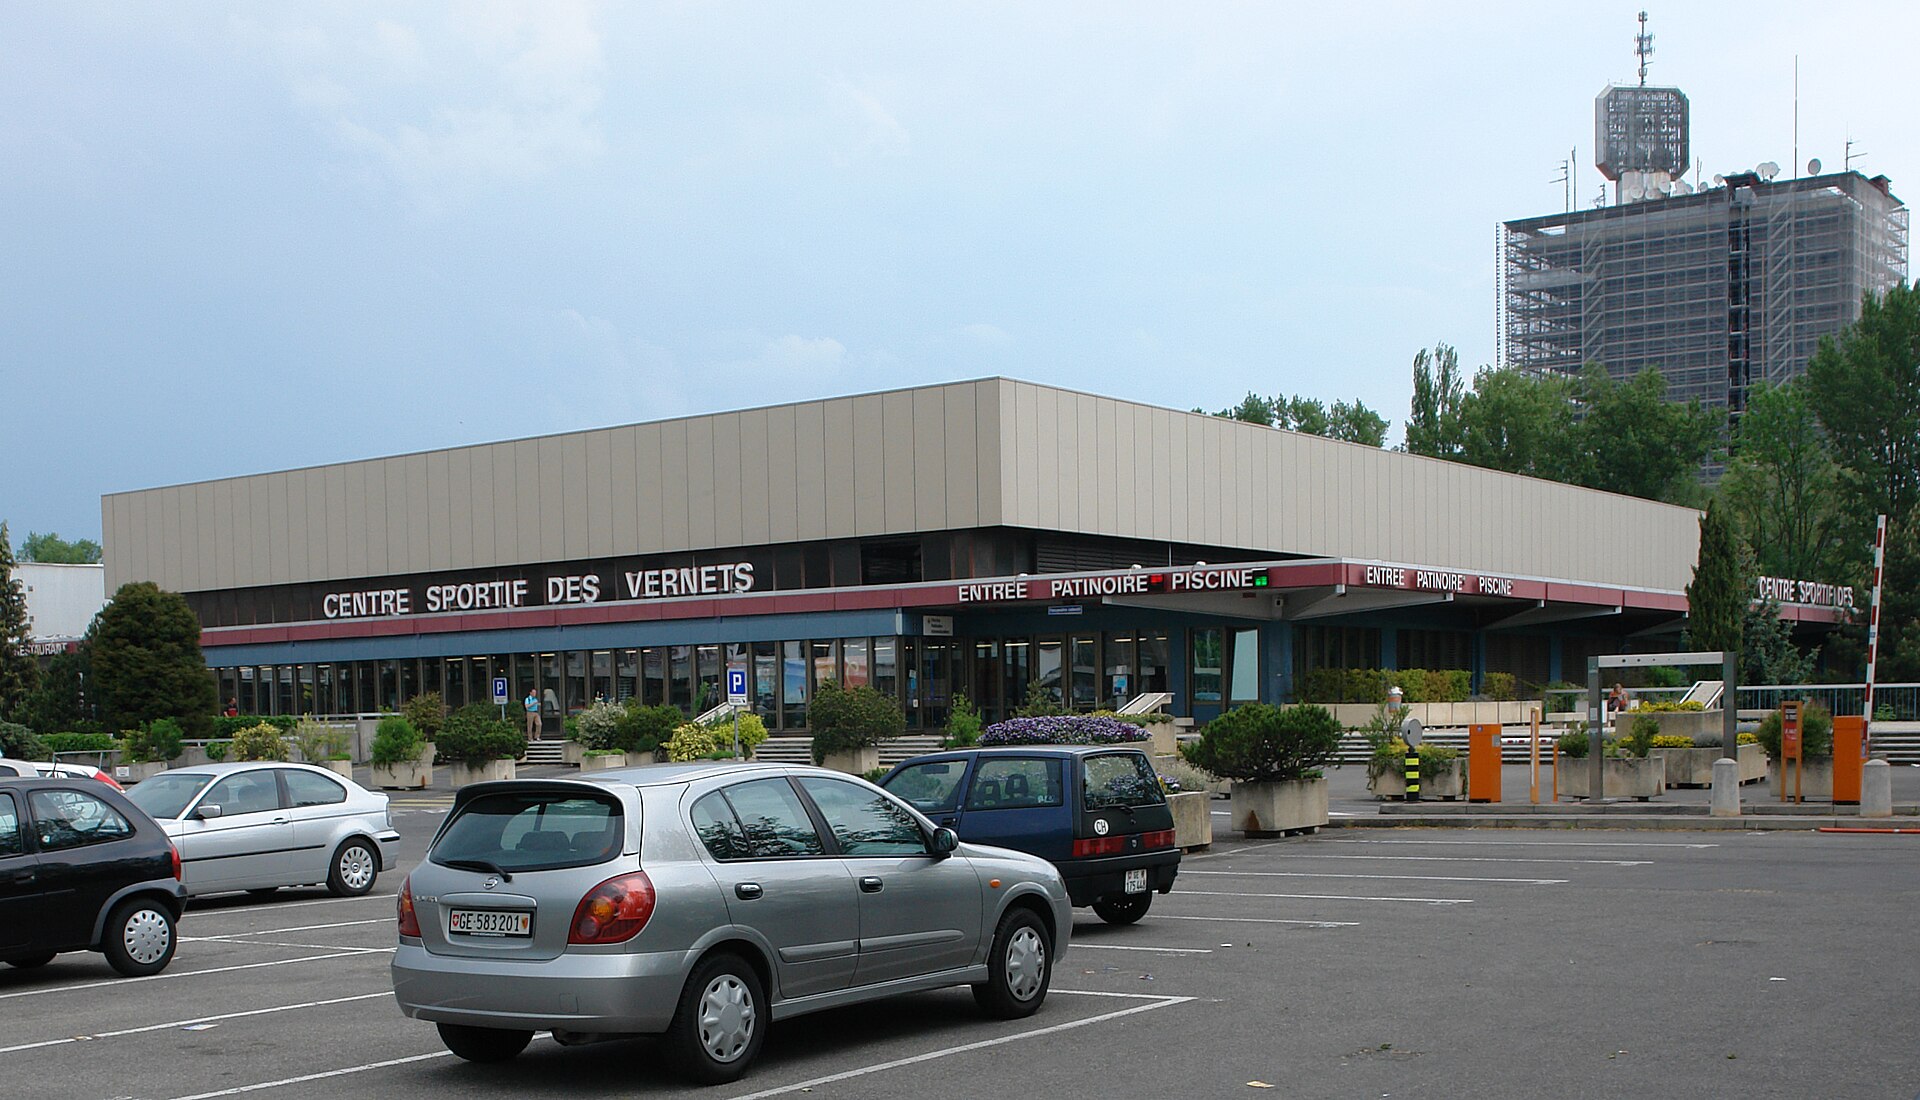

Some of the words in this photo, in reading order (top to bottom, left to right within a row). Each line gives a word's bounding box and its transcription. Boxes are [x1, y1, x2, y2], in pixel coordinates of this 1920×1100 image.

[323, 589, 409, 618] CENTRE
[426, 579, 529, 611] SPORTIF
[548, 574, 600, 603] DES
[625, 562, 754, 598] VERNETS
[958, 582, 1027, 602] ENTREE
[1051, 575, 1148, 597] PATINOIRE
[1172, 569, 1253, 590] PISCINE
[1366, 566, 1405, 586] ENTREE
[1416, 571, 1463, 591] PATINOIRE
[1479, 576, 1512, 595] PISCINE
[1759, 576, 1796, 602] CENTRE
[1798, 580, 1835, 605] SPORTIF
[1838, 586, 1854, 607] DES
[496, 681, 503, 695] P
[733, 673, 742, 692] P
[1096, 821, 1107, 833] CH
